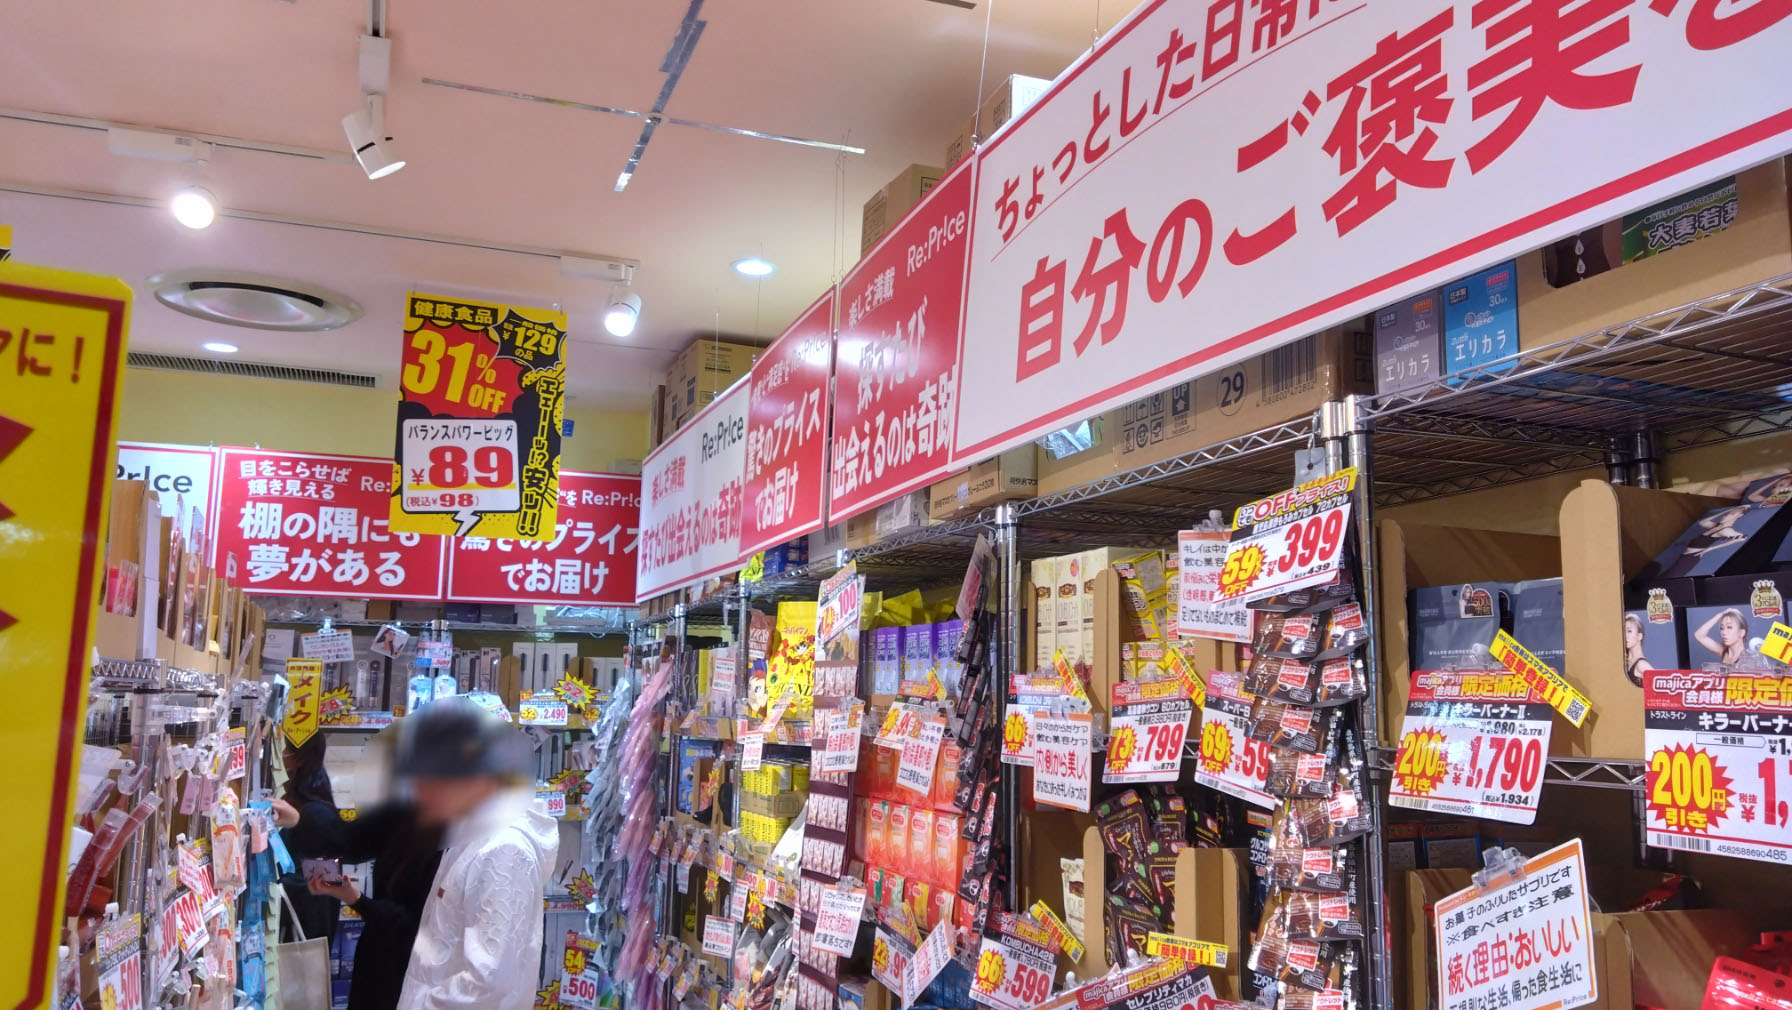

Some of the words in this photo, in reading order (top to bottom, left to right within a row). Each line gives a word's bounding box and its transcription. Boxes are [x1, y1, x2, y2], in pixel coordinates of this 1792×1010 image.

[414, 301, 493, 325] 健康食品
[1455, 329, 1507, 361] エリカラ
[1385, 354, 1431, 382] エリカラ
[467, 384, 507, 414] OFF
[1220, 371, 1245, 408] 29
[240, 460, 351, 483] 目をこらせば
[247, 480, 336, 500] 輝き見える
[755, 461, 799, 533] でお届け
[246, 544, 407, 587] 夢がある
[501, 558, 609, 595] でお届け
[1223, 582, 1249, 596] OFF
[1461, 674, 1529, 698] 限定価格
[1655, 676, 1726, 692] majicaアプリ
[290, 675, 315, 725] メイク
[1685, 690, 1724, 705] 会員様
[1650, 711, 1687, 721] トラストライン
[1036, 734, 1089, 747] 飲む美容ケア
[1144, 723, 1184, 762] 799
[1713, 738, 1745, 747] 一般価格
[1035, 748, 1089, 782] 内側から美しく
[1110, 759, 1126, 771] OFF
[1204, 759, 1223, 774] OFF
[1398, 731, 1447, 778] 200円
[1403, 775, 1431, 792] 引き
[1651, 751, 1727, 813] 200円
[1665, 807, 1708, 830] 引き
[1445, 865, 1573, 930] お菓子のふりしたサプリです
[564, 948, 584, 967] 54
[568, 977, 595, 1001] 500
[1011, 963, 1050, 1005] 599
[1126, 973, 1193, 1010] セレブリティマカ
